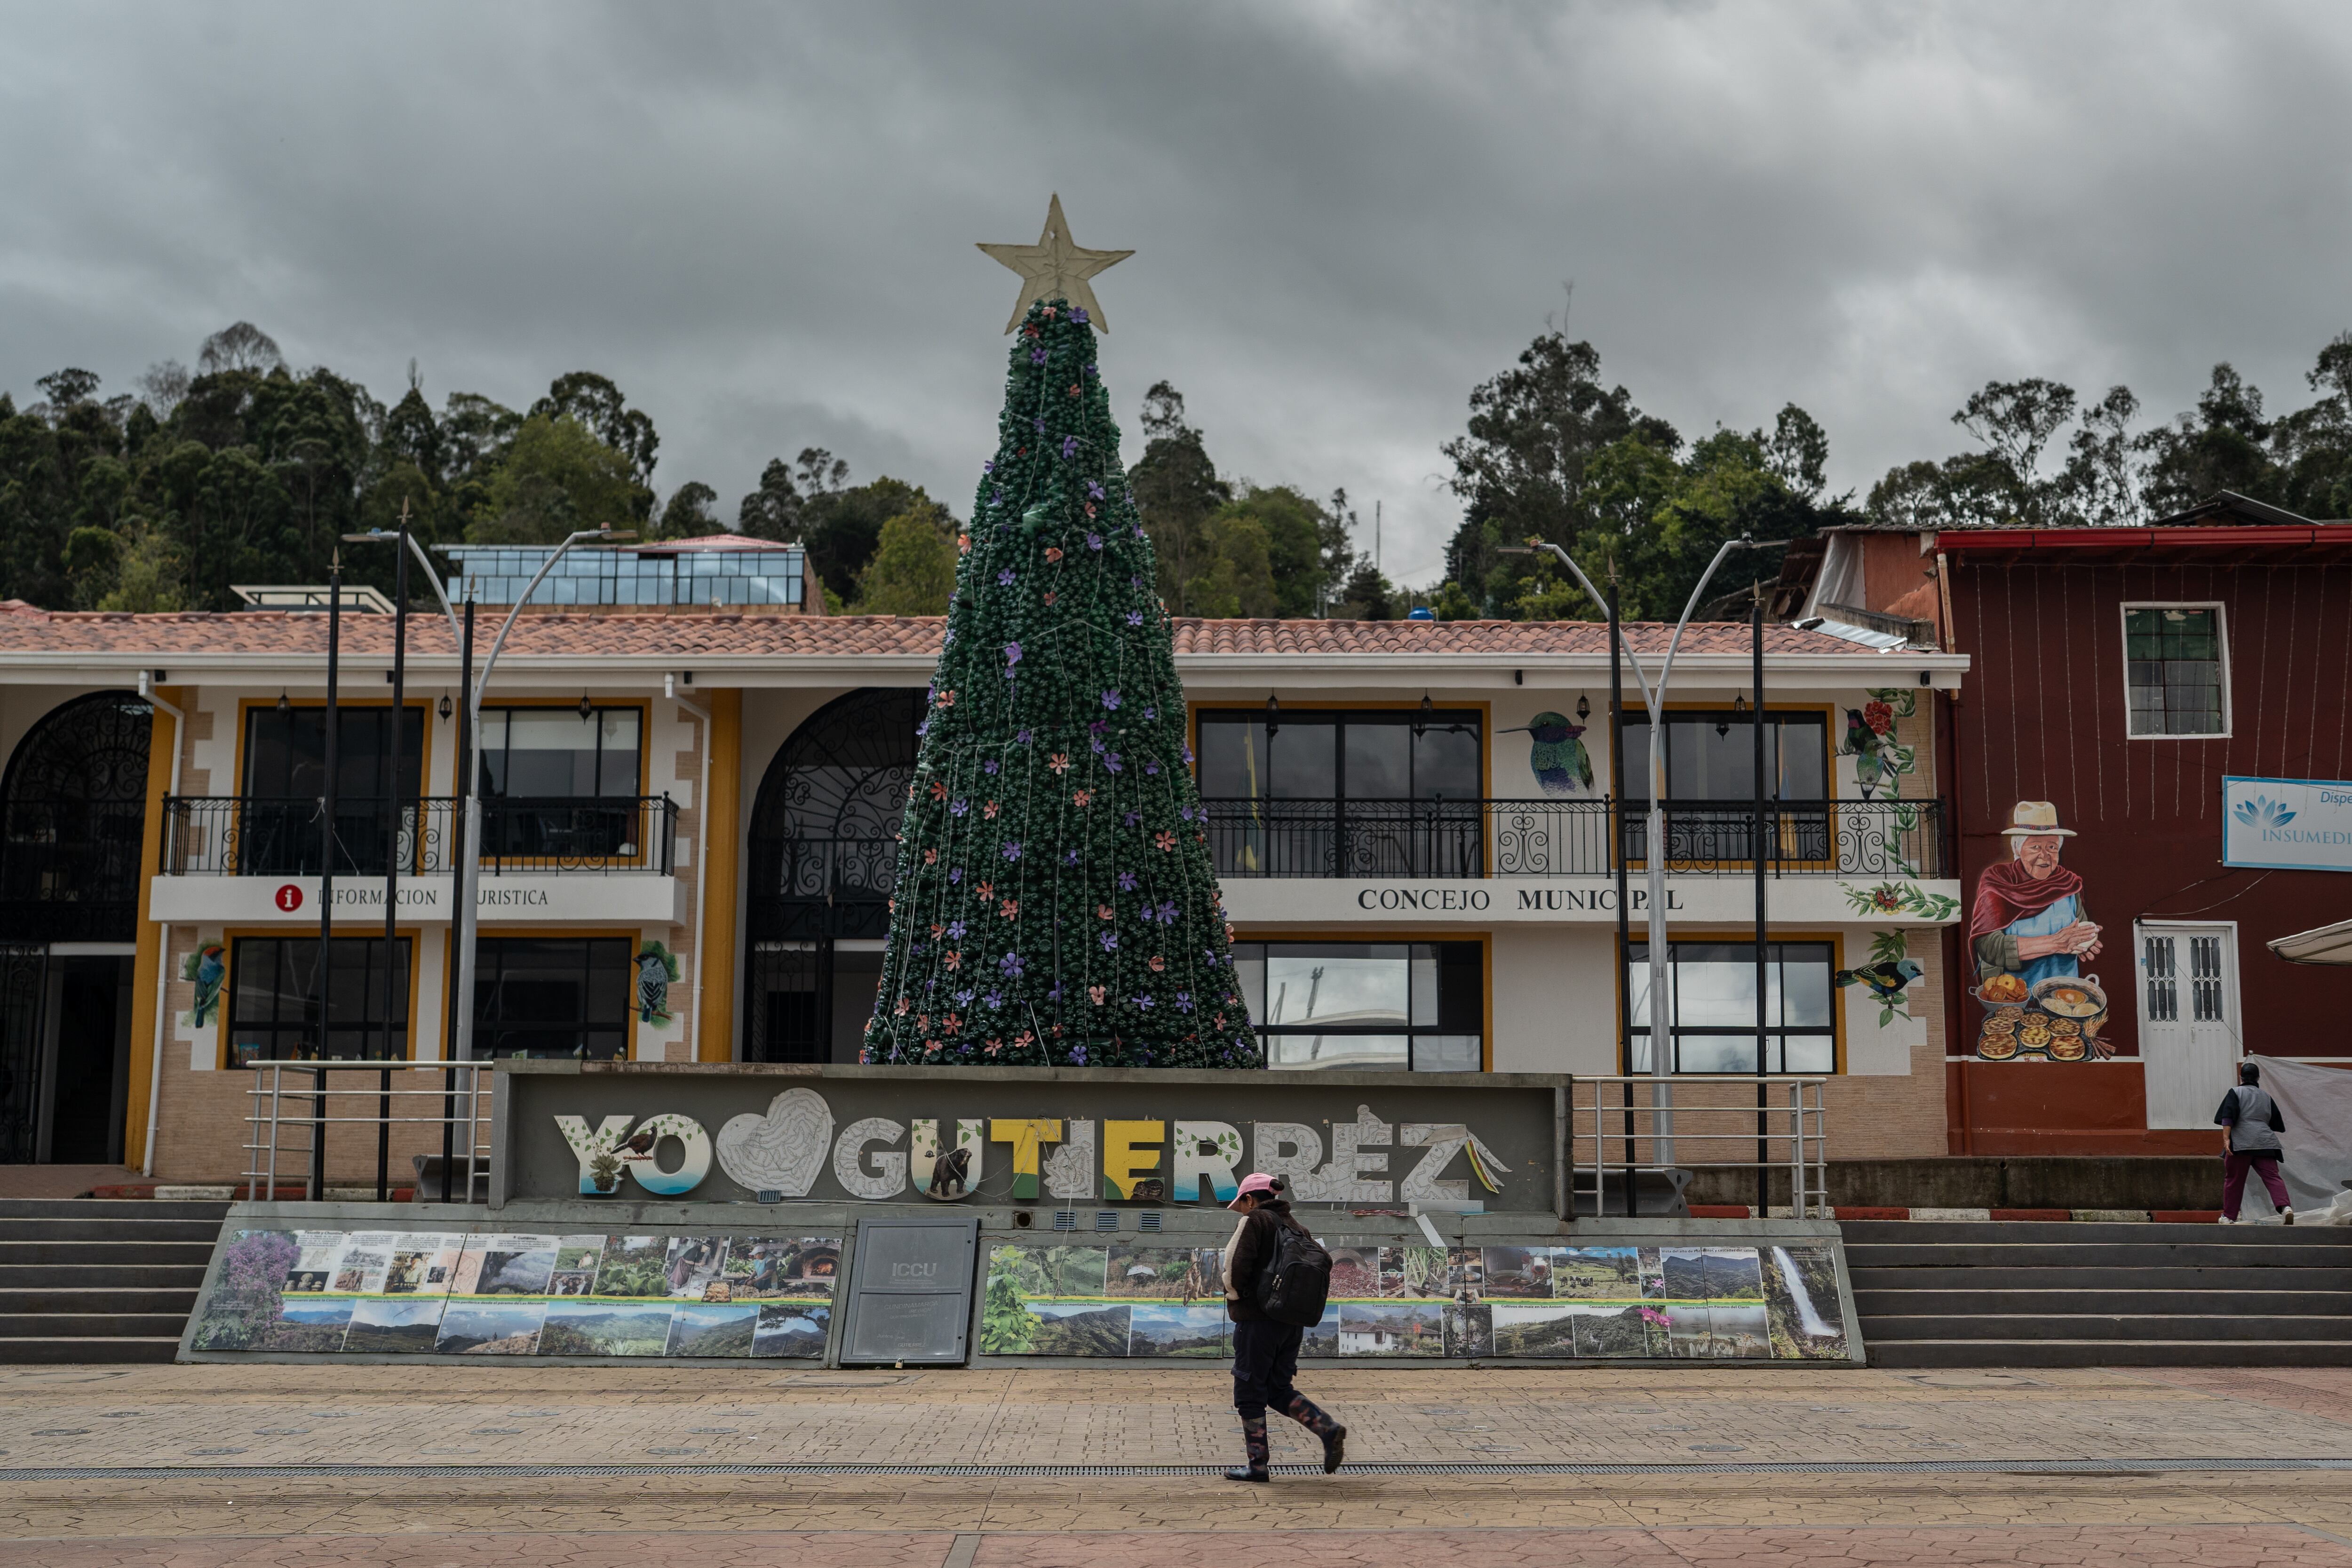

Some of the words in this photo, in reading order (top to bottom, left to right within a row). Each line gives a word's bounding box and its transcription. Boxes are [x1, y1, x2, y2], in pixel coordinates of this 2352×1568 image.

[318, 889, 437, 905] IFORMCION
[477, 890, 548, 905] URISTICA
[1358, 889, 1490, 910] CONCEJO
[1517, 890, 1684, 910] MUNICPL
[553, 1113, 714, 1195] YO
[892, 1263, 937, 1277] ICCU
